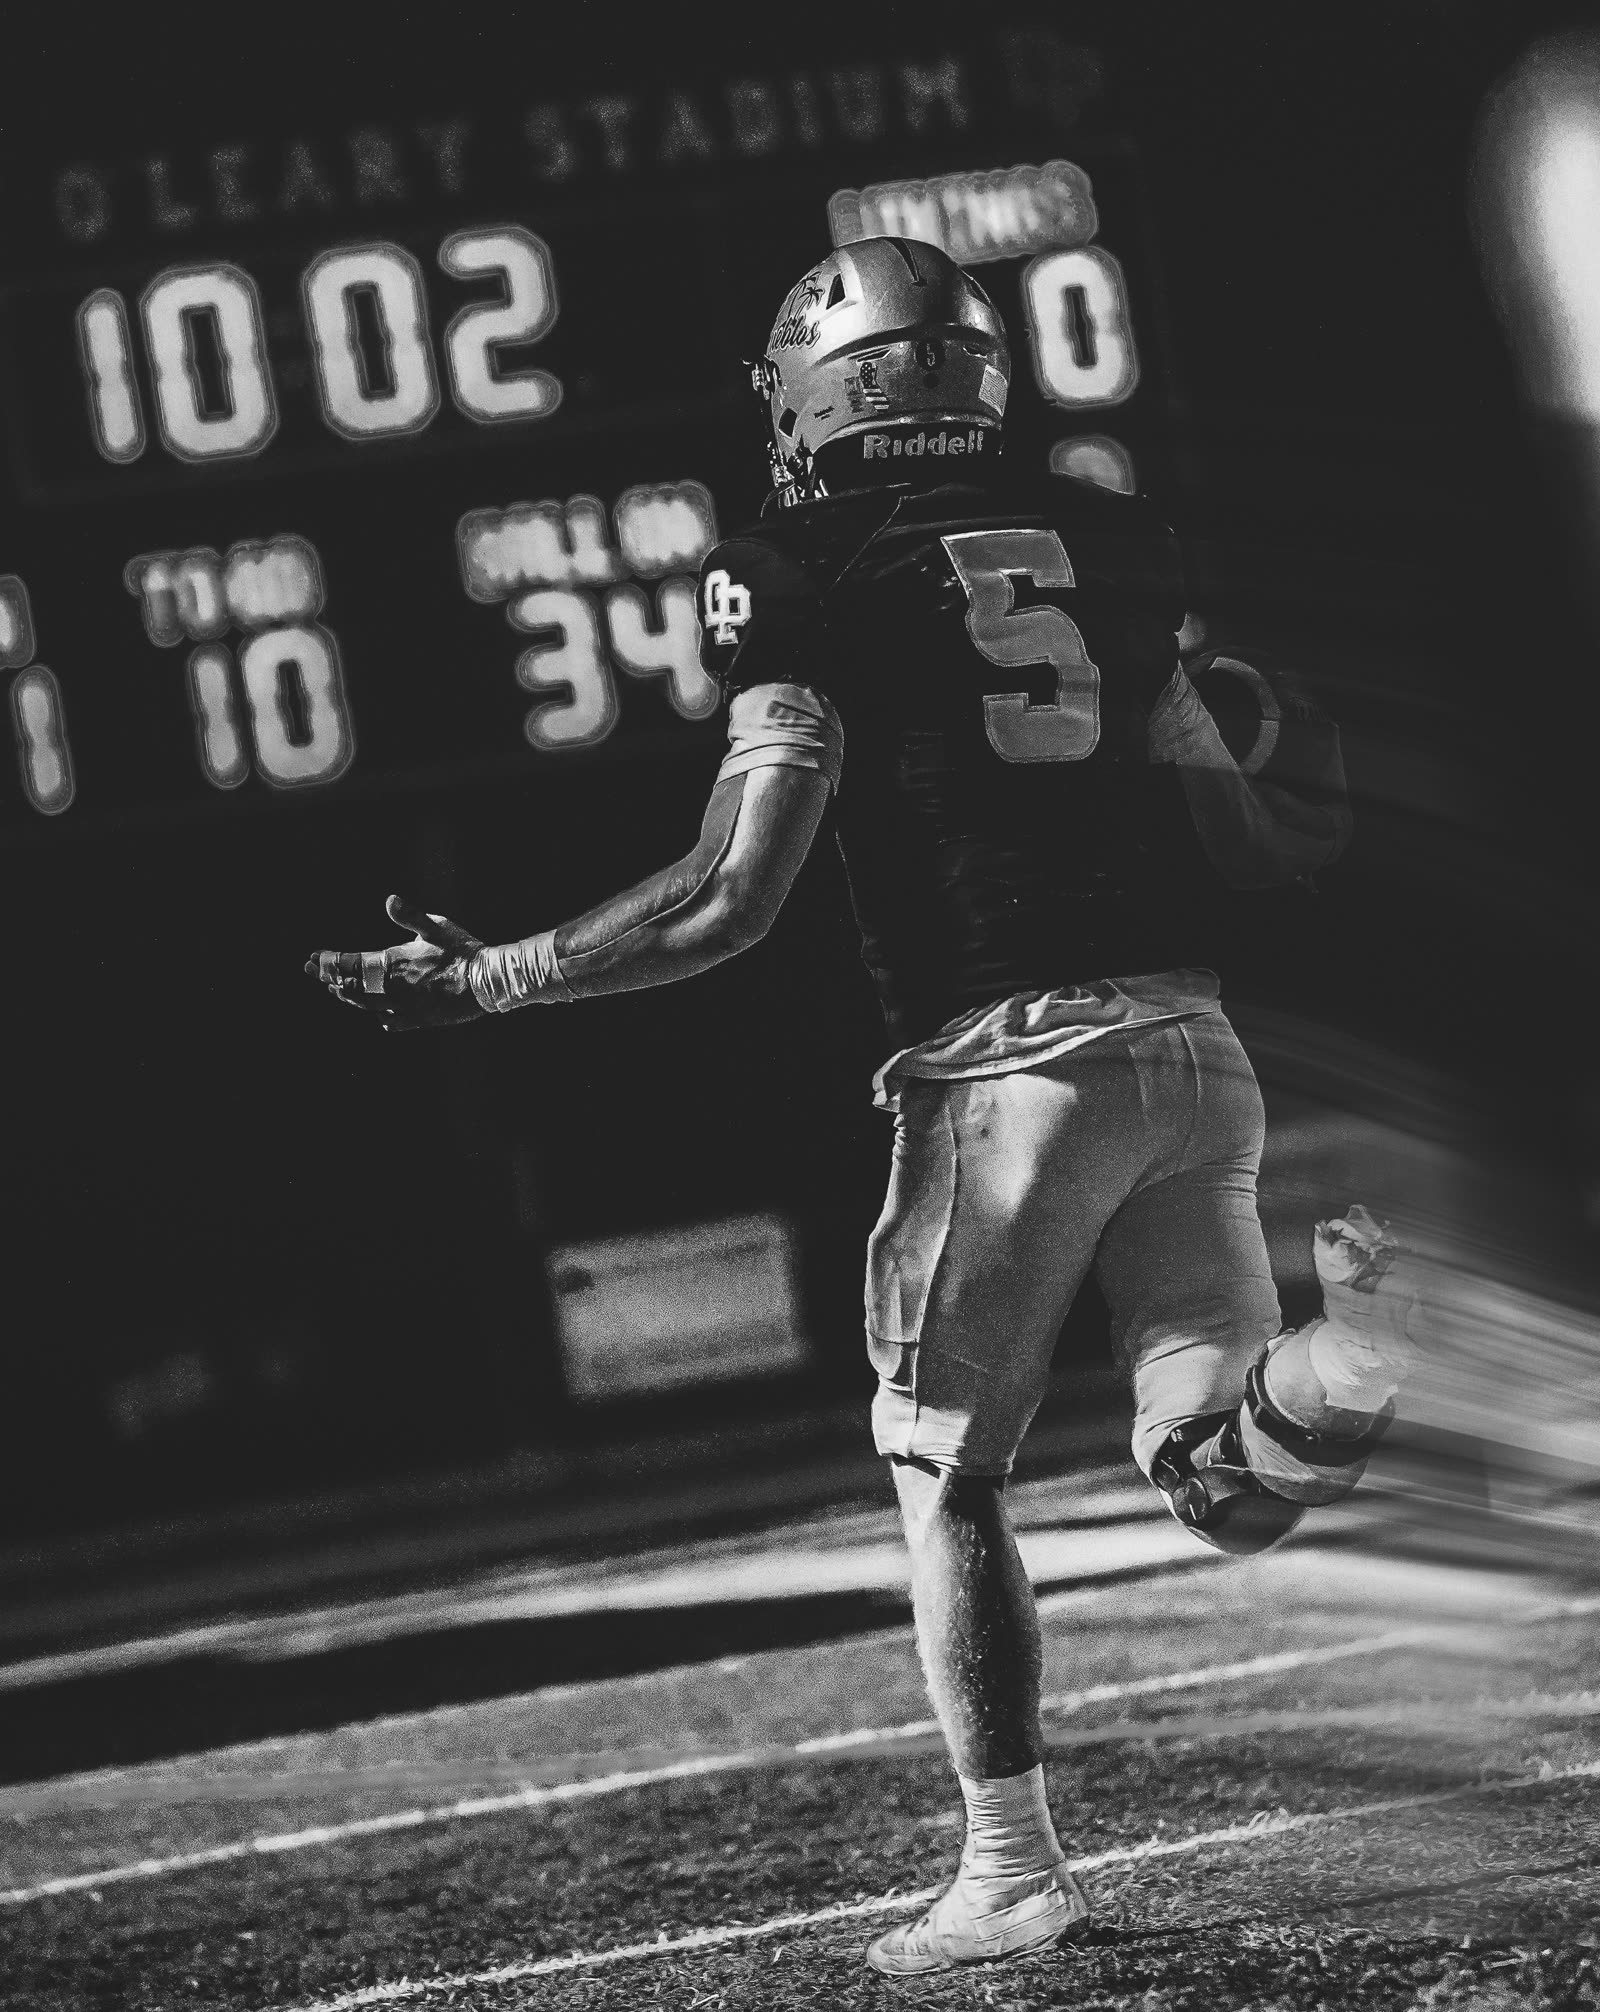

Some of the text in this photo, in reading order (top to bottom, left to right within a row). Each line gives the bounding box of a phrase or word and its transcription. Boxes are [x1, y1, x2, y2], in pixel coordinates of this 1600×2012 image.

[522, 54, 970, 183] STADIUM
[925, 343, 936, 367] 5
[1023, 247, 1140, 408] 0
[863, 430, 984, 459] Riddell
[187, 624, 354, 788] 10
[508, 577, 719, 750] 34
[940, 529, 1100, 763] 5
